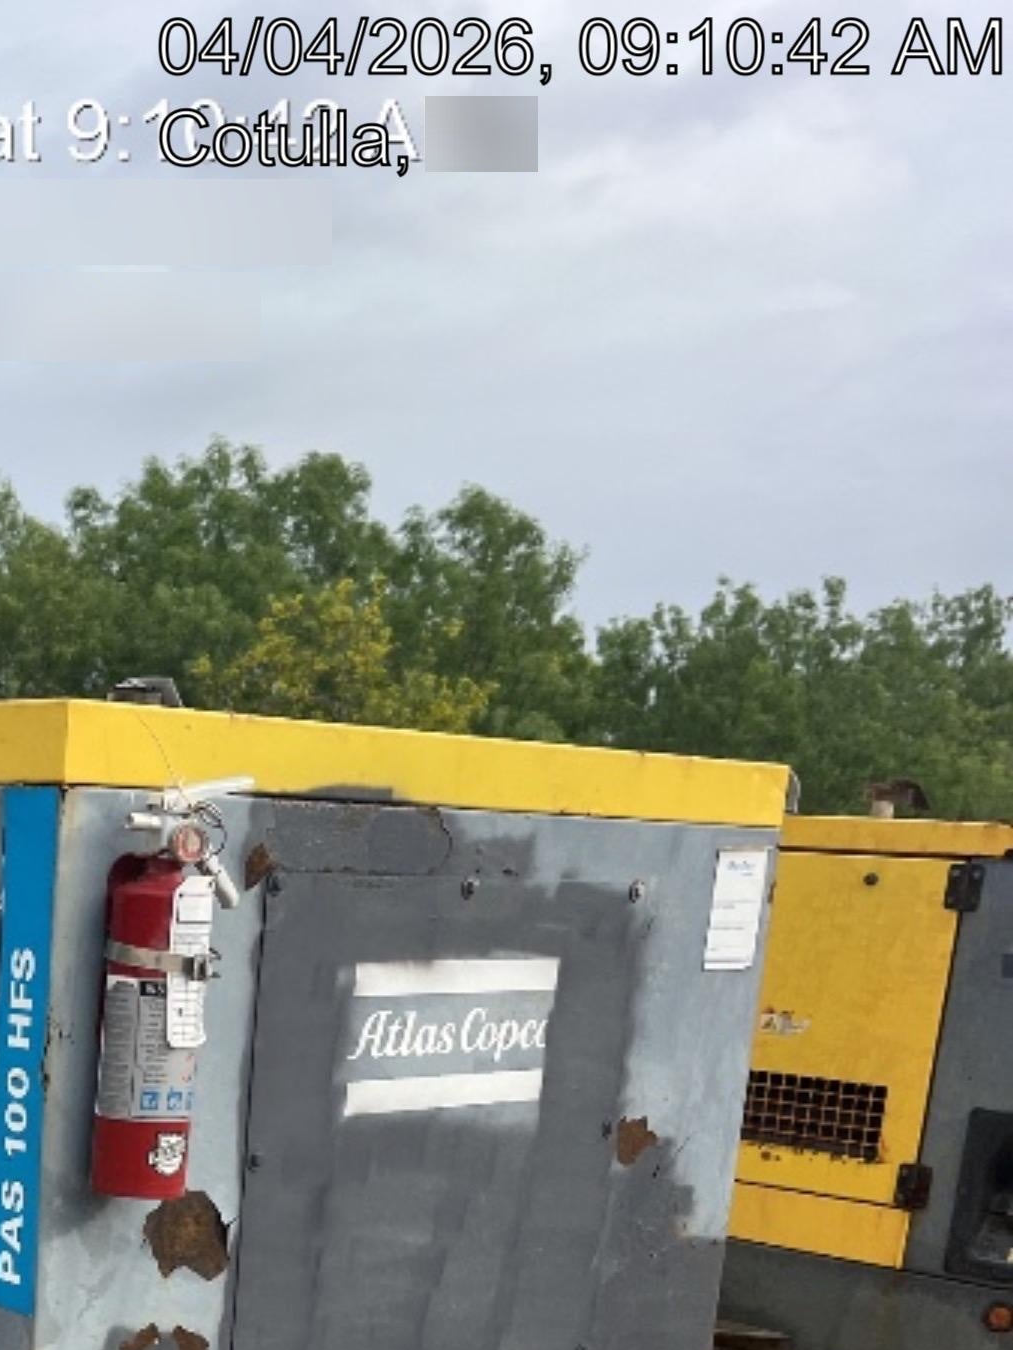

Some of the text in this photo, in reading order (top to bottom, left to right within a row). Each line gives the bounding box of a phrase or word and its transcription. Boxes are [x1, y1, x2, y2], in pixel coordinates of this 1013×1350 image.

[7, 947, 37, 1051] HFS
[346, 1009, 456, 1060] Atlas
[3, 1066, 30, 1157] 100
